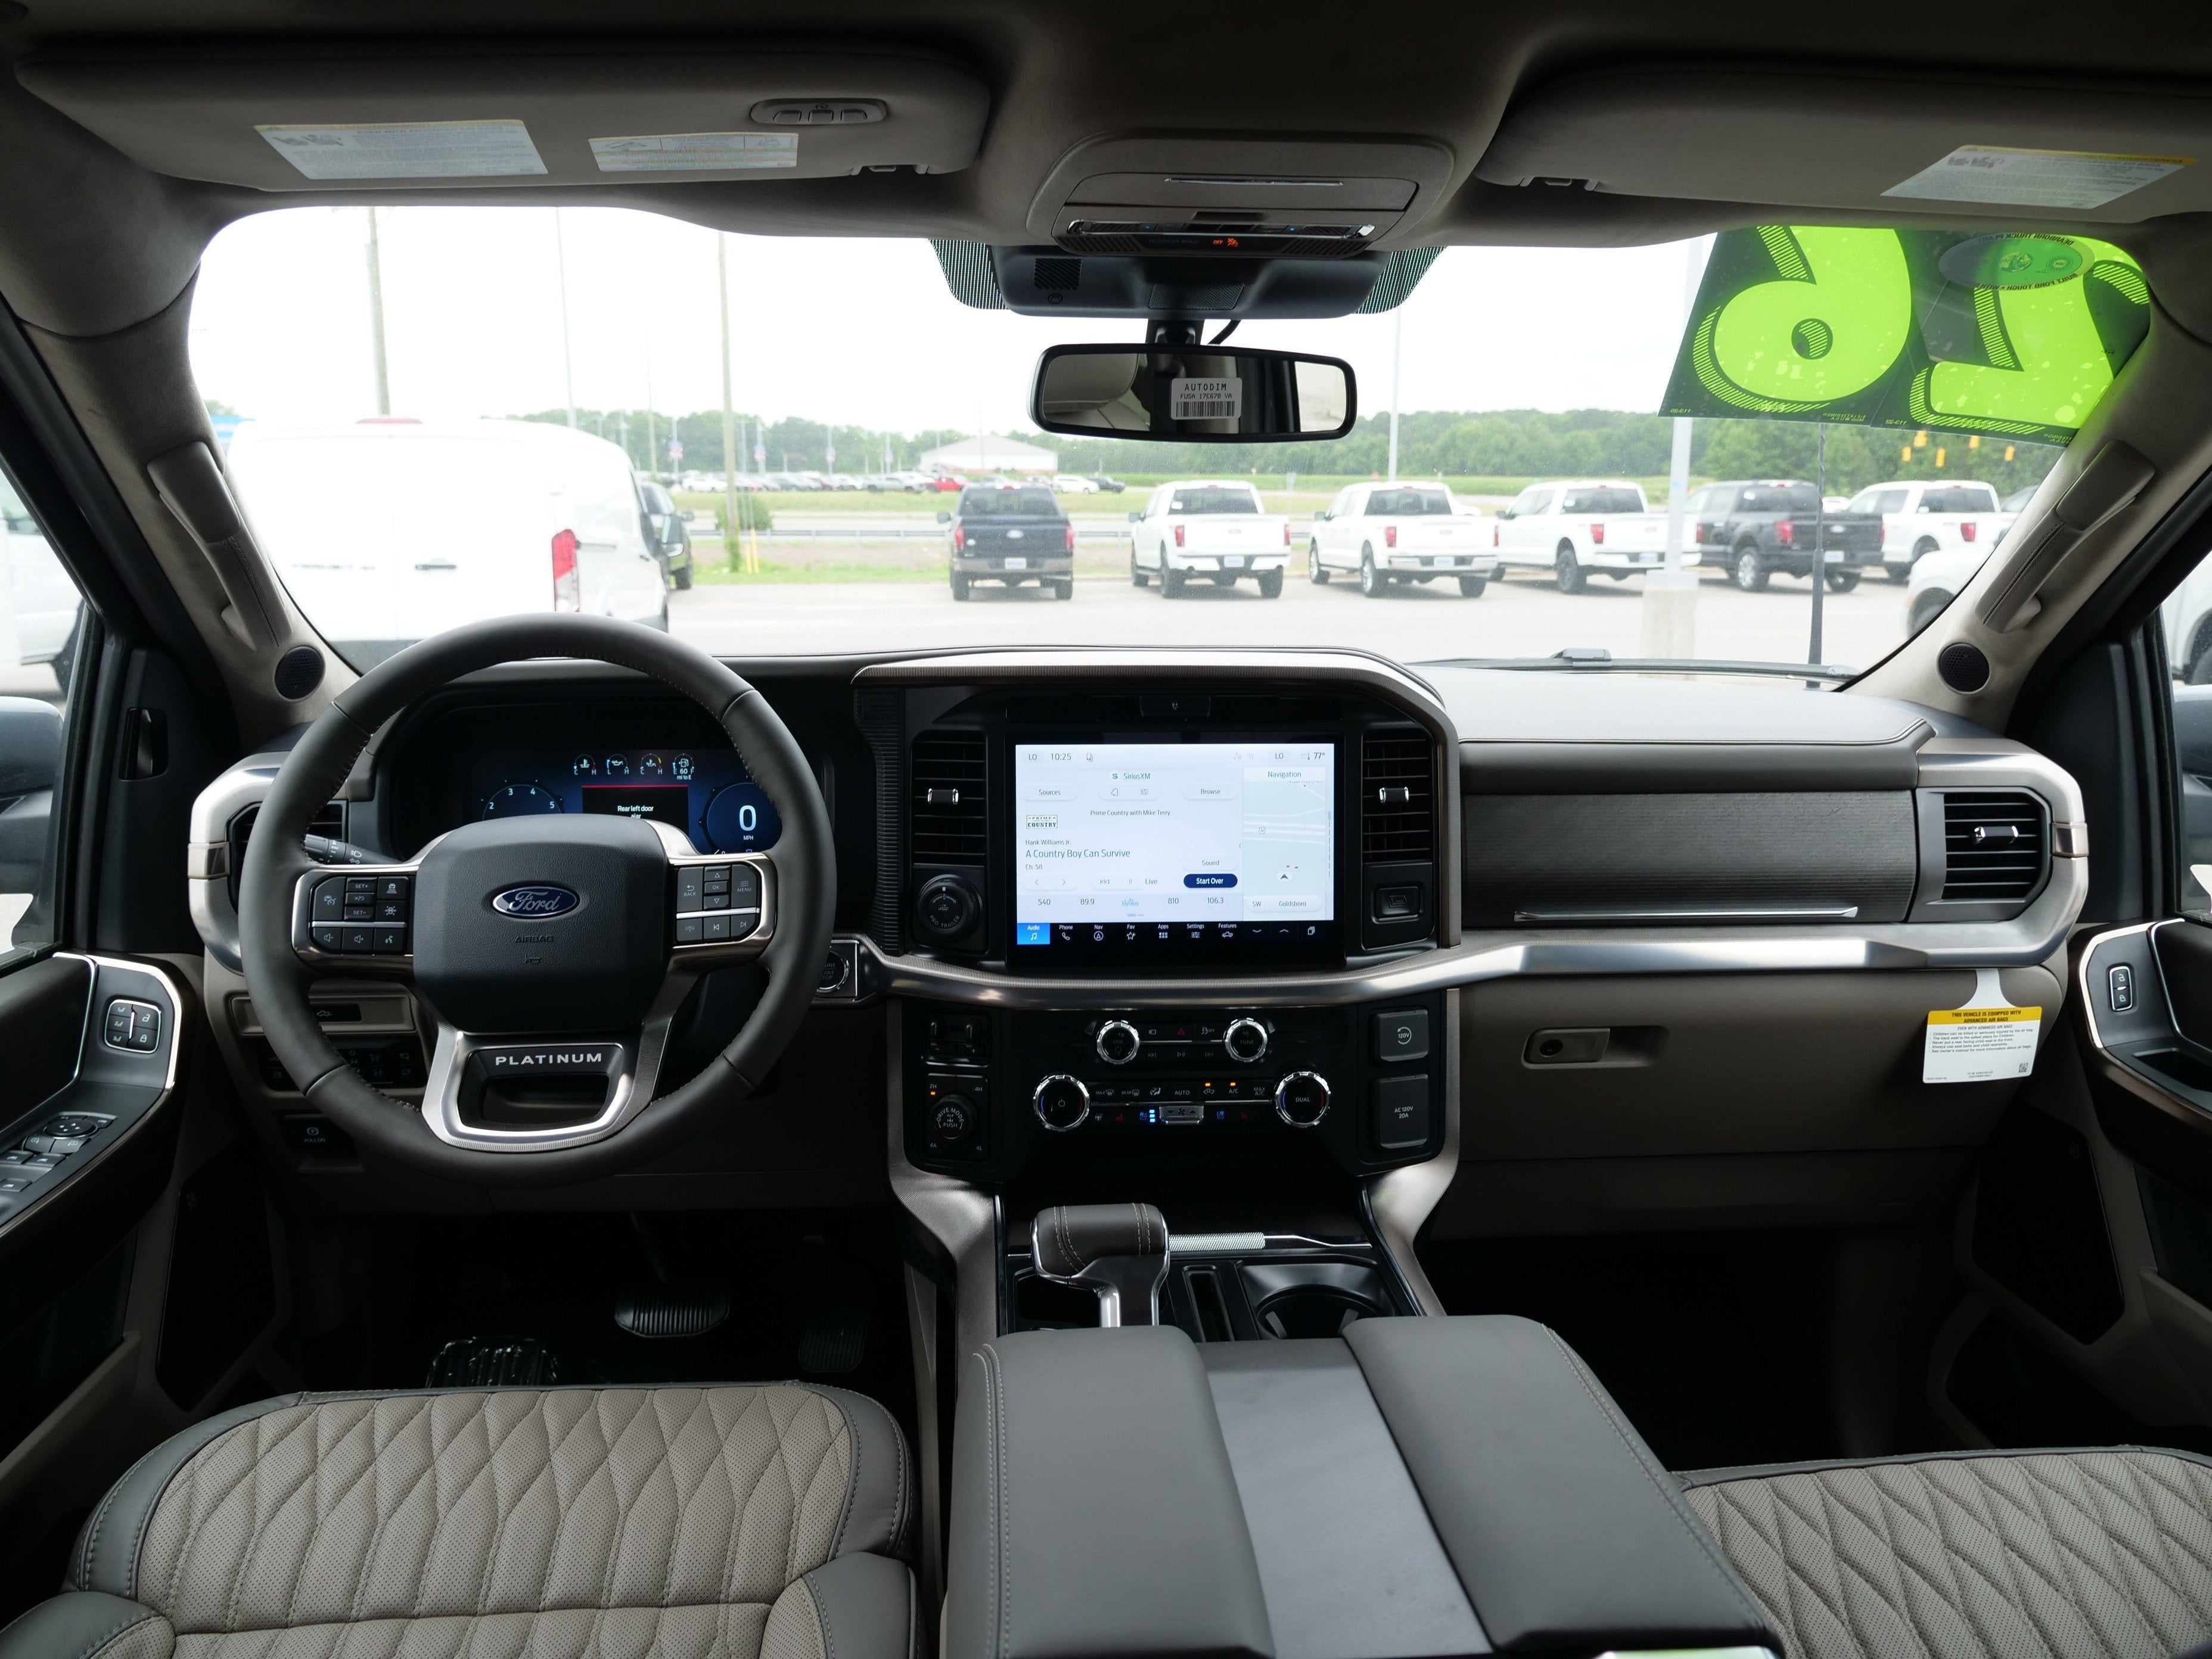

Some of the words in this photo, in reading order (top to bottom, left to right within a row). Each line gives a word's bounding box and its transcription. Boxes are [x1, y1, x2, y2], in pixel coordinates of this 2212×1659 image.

[739, 805, 756, 832] 0
[1033, 850, 1065, 859] Country
[1067, 849, 1082, 859] Boy
[1084, 849, 1099, 858] Can
[1101, 849, 1130, 858] Survive
[508, 890, 559, 912] Ford
[930, 915, 939, 926] PRO
[941, 915, 961, 928] TRAILER
[495, 1052, 602, 1065] PLATINUM
[936, 1107, 949, 1122] DRIVE
[950, 1107, 964, 1123] MODE
